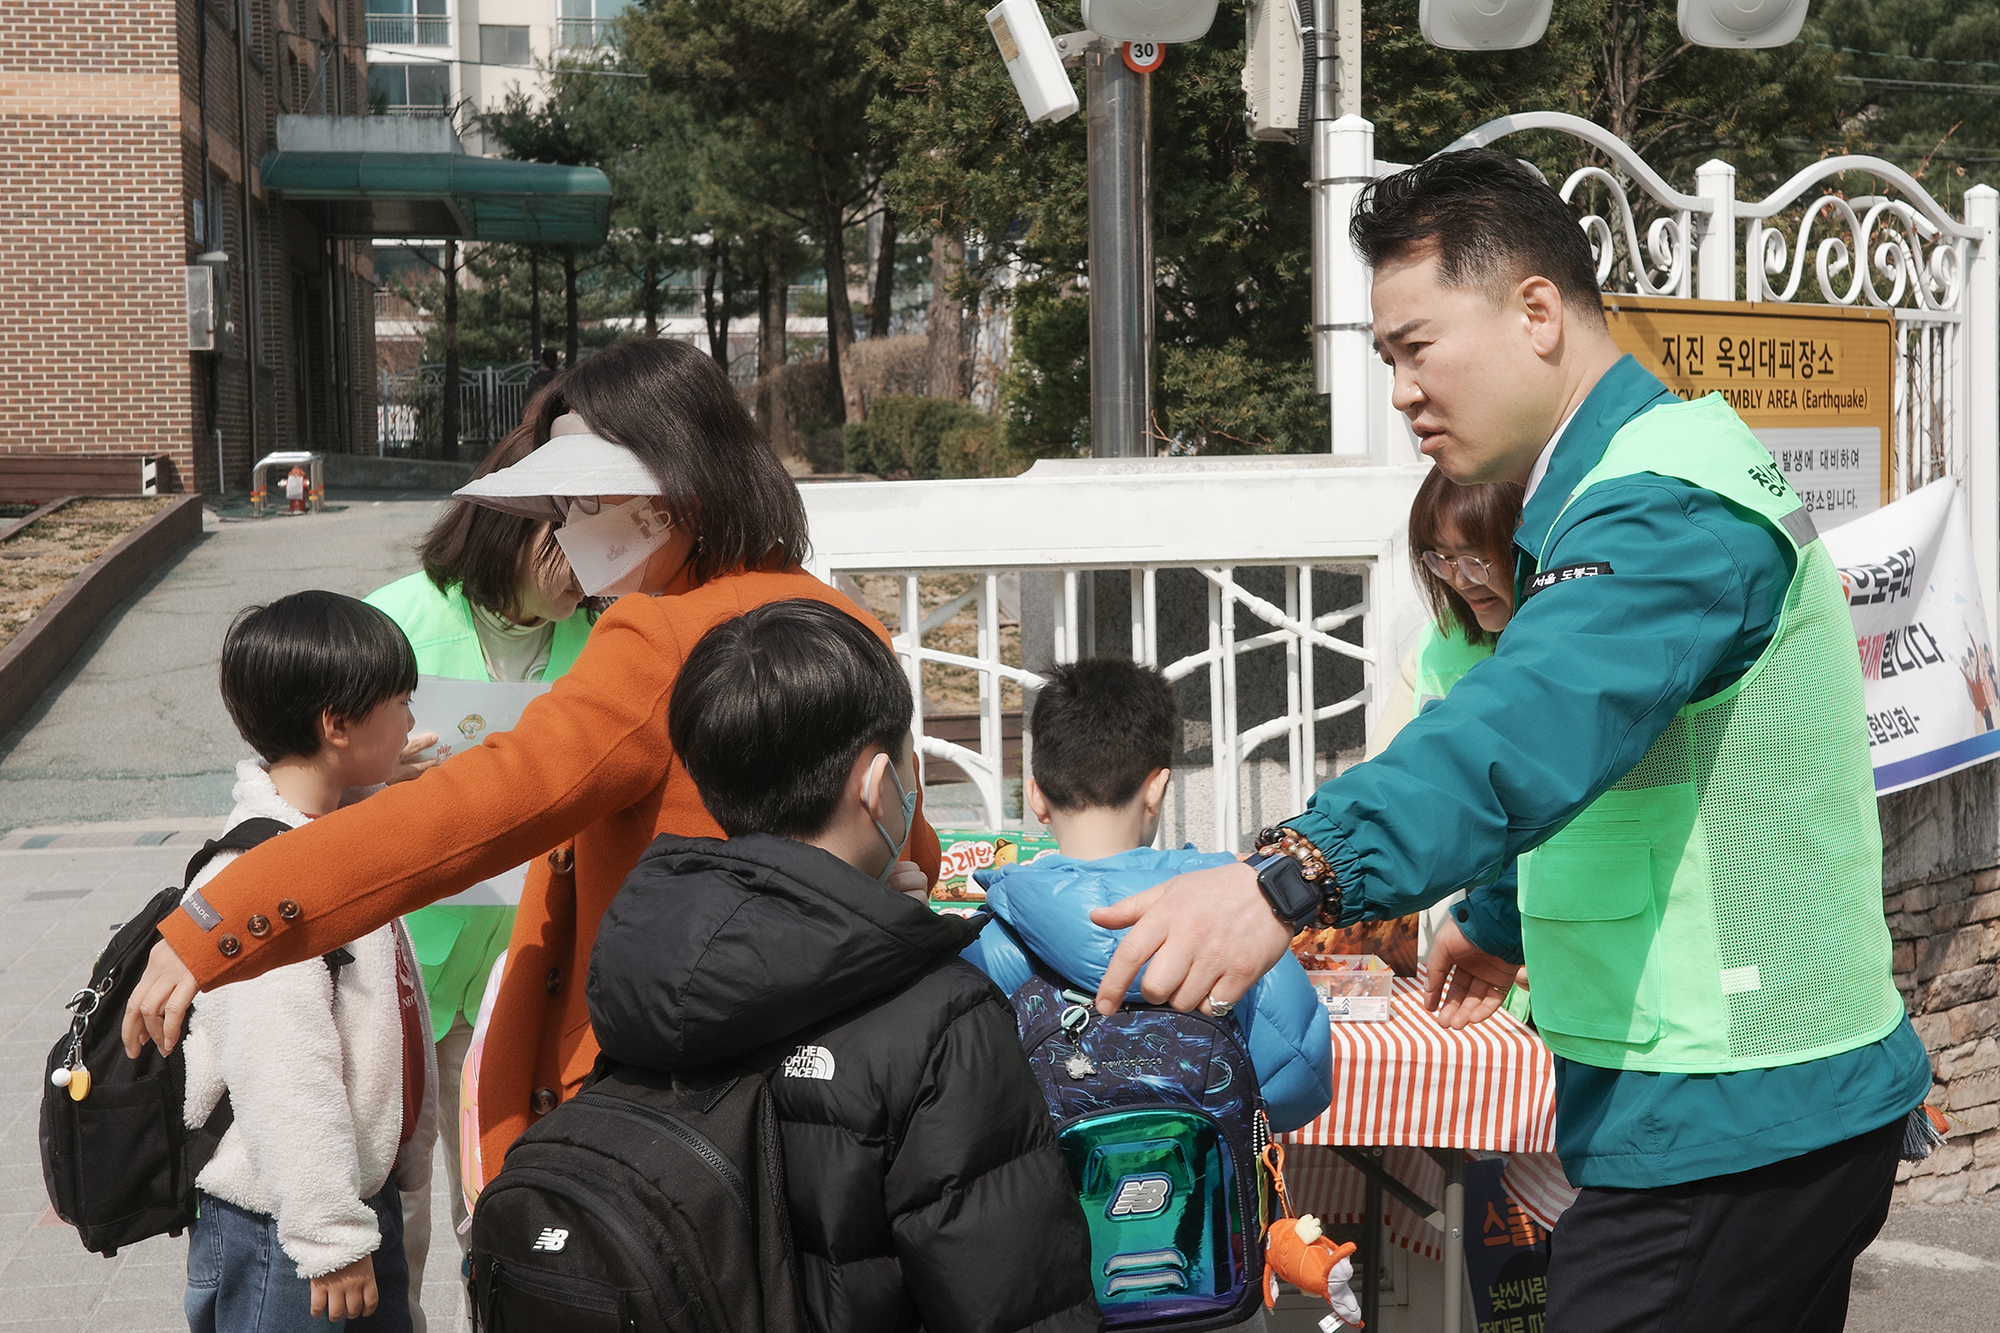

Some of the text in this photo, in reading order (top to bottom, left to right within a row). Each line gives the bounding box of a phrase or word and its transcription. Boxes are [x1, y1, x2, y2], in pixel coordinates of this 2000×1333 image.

[1134, 43, 1154, 58] 30
[1661, 334, 1834, 379] 지진 옥외대피장소
[1699, 389, 1763, 410] EMBLY
[1767, 390, 1798, 409] AREA
[1802, 388, 1868, 414] (Earthquake)
[1782, 449, 1813, 472] 발생에
[1820, 448, 1859, 471] 대비하여
[1532, 567, 1598, 587] 서울 도봉구
[1840, 546, 1916, 606] 으로부터
[1867, 705, 1921, 747] 협의회-
[795, 1045, 817, 1057] THE
[784, 1066, 813, 1078] FACE
[1483, 1197, 1547, 1247] 스쿨
